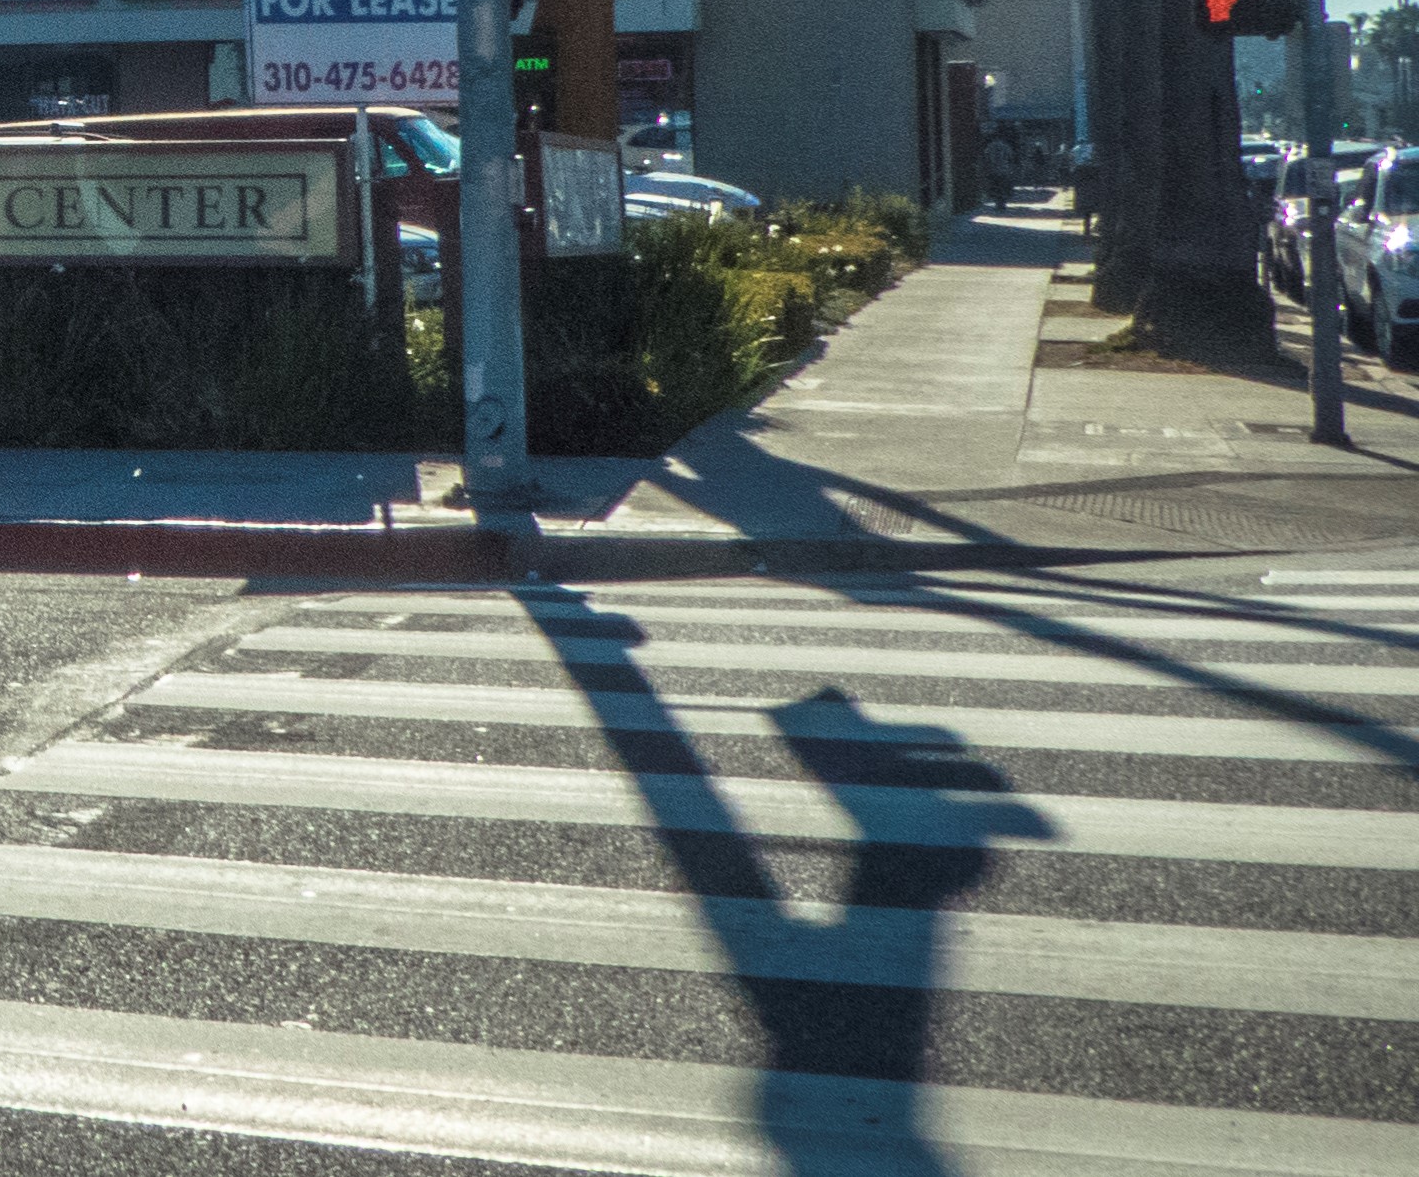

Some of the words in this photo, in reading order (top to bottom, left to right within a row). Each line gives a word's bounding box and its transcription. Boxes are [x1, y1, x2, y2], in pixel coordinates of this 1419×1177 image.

[264, 60, 460, 93] 310-475-6428
[515, 57, 550, 71] ATM
[5, 184, 273, 231] CENTER
